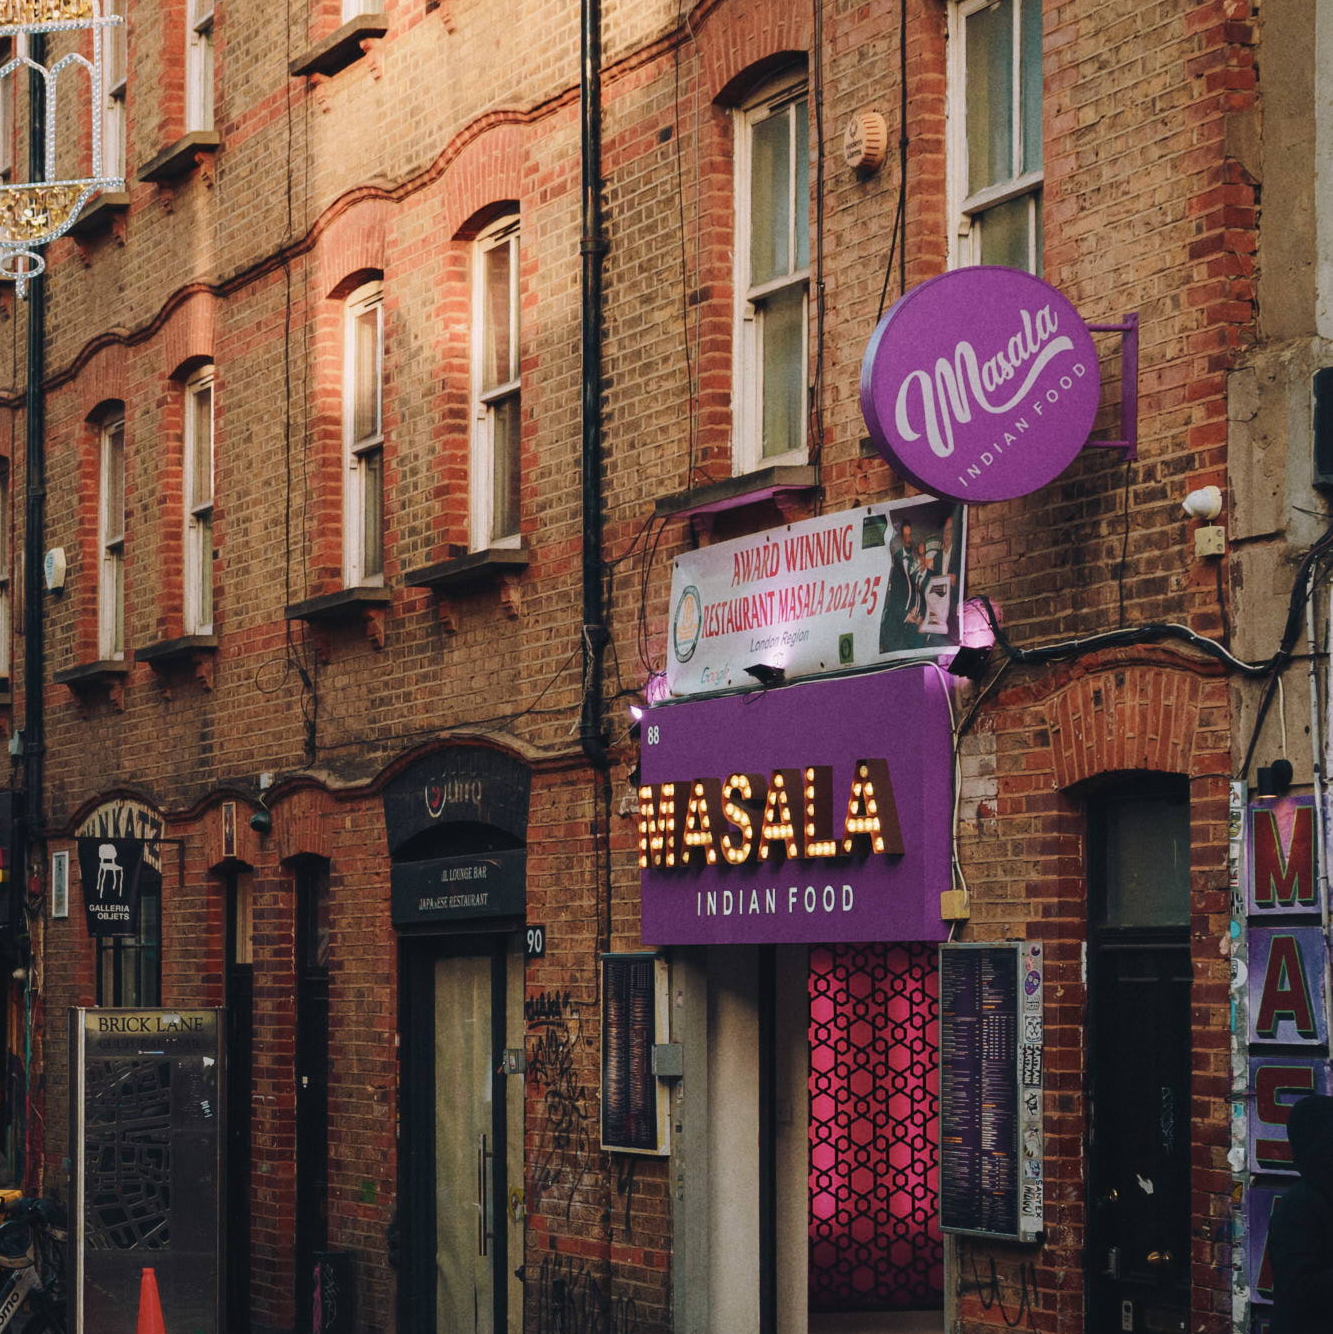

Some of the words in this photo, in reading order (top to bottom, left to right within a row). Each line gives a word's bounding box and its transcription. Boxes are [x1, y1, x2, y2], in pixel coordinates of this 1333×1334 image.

[895, 304, 1074, 458] Masala
[958, 417, 1030, 487] INDIAN
[1034, 363, 1087, 416] FOOD
[731, 542, 780, 588] AWARD
[784, 524, 854, 573] WINNING
[701, 589, 776, 639] RESTAURANT
[777, 580, 825, 625] MASALA
[826, 575, 882, 619] 2024-25
[749, 635, 780, 653] London
[781, 628, 809, 648] Region
[647, 725, 660, 745] 88
[639, 758, 890, 868] MASALA
[449, 868, 473, 882] LOUNGE
[473, 866, 487, 879] BAR
[89, 904, 130, 913] GALLERIA
[449, 893, 489, 909] RESTAURANT
[697, 889, 776, 916] INDIAN
[788, 885, 854, 913] FOOD
[97, 913, 130, 921] OBJETS
[527, 929, 542, 953] 90
[98, 1016, 151, 1033] BRICK
[157, 1017, 204, 1033] LANE
